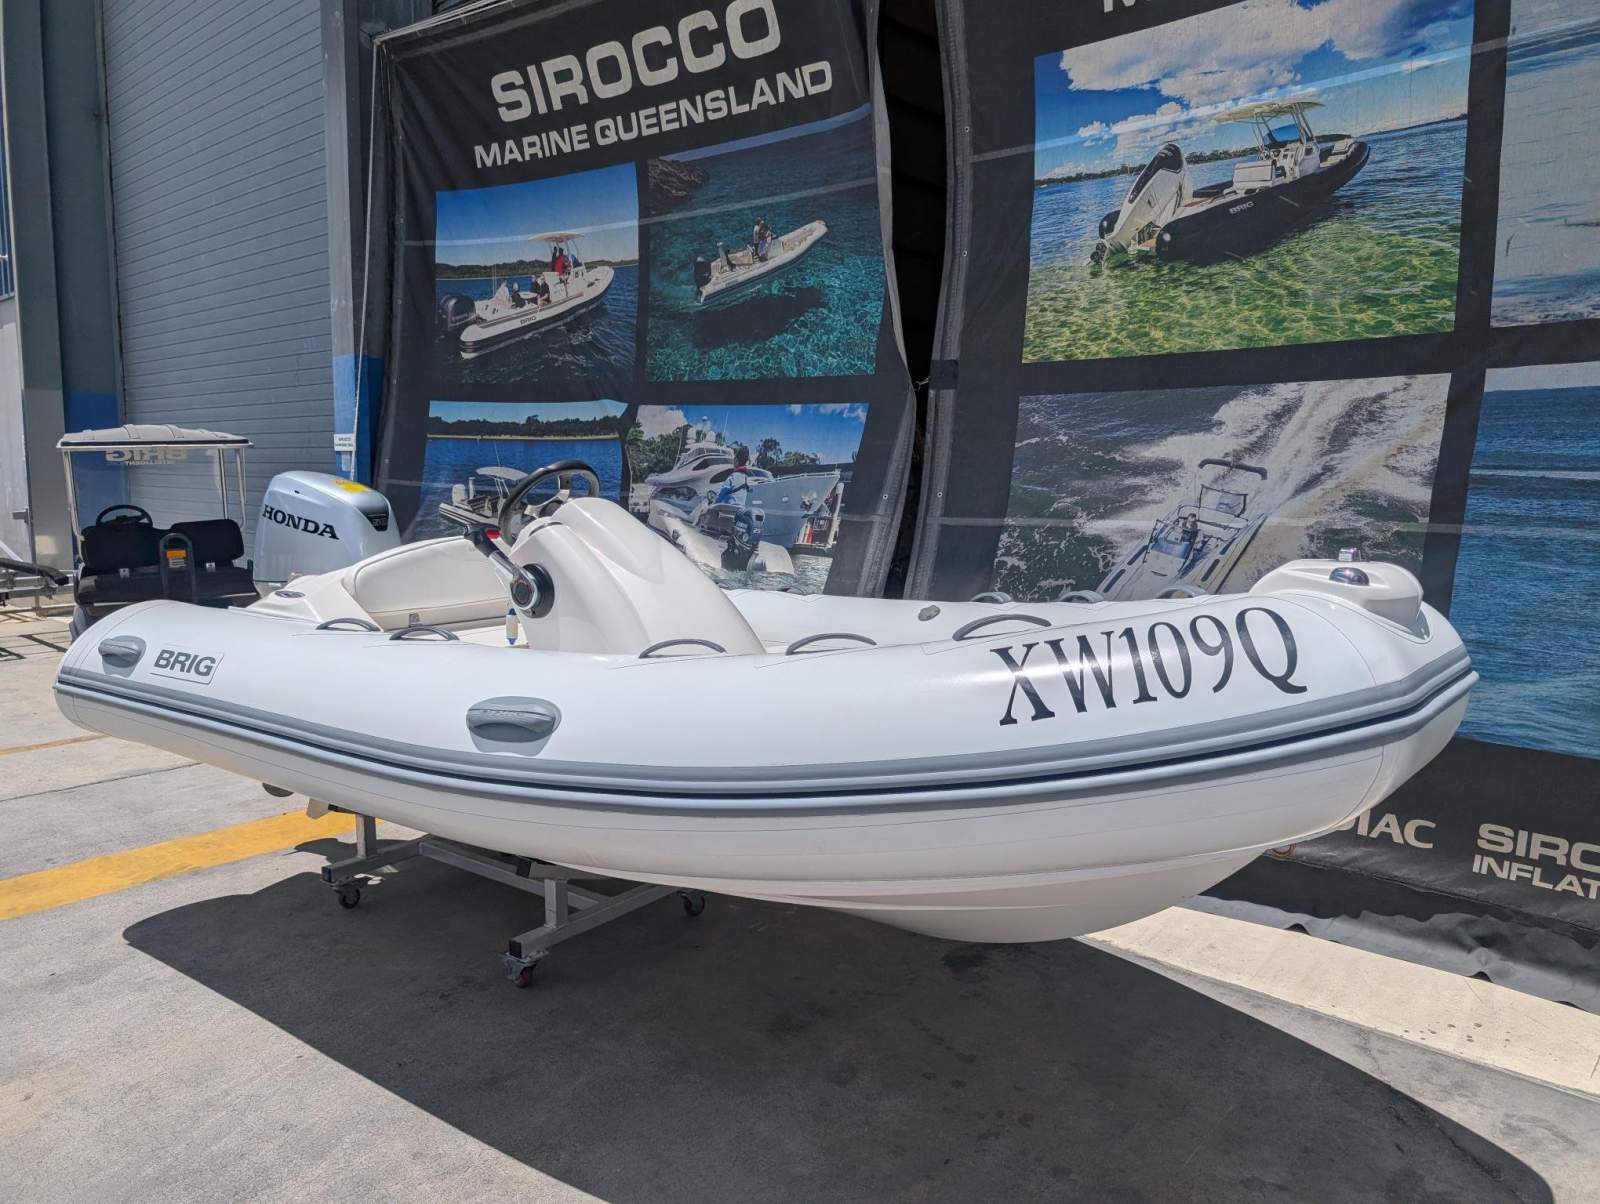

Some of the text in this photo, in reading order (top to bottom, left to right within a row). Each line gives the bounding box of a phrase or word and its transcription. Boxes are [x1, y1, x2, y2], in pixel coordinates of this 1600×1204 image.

[474, 60, 833, 169] MARINE QUEENSLAND
[491, 0, 781, 122] SIROCCO
[262, 504, 340, 541] HONDA
[153, 649, 217, 677] BRIG
[990, 607, 1308, 727] XW109Q
